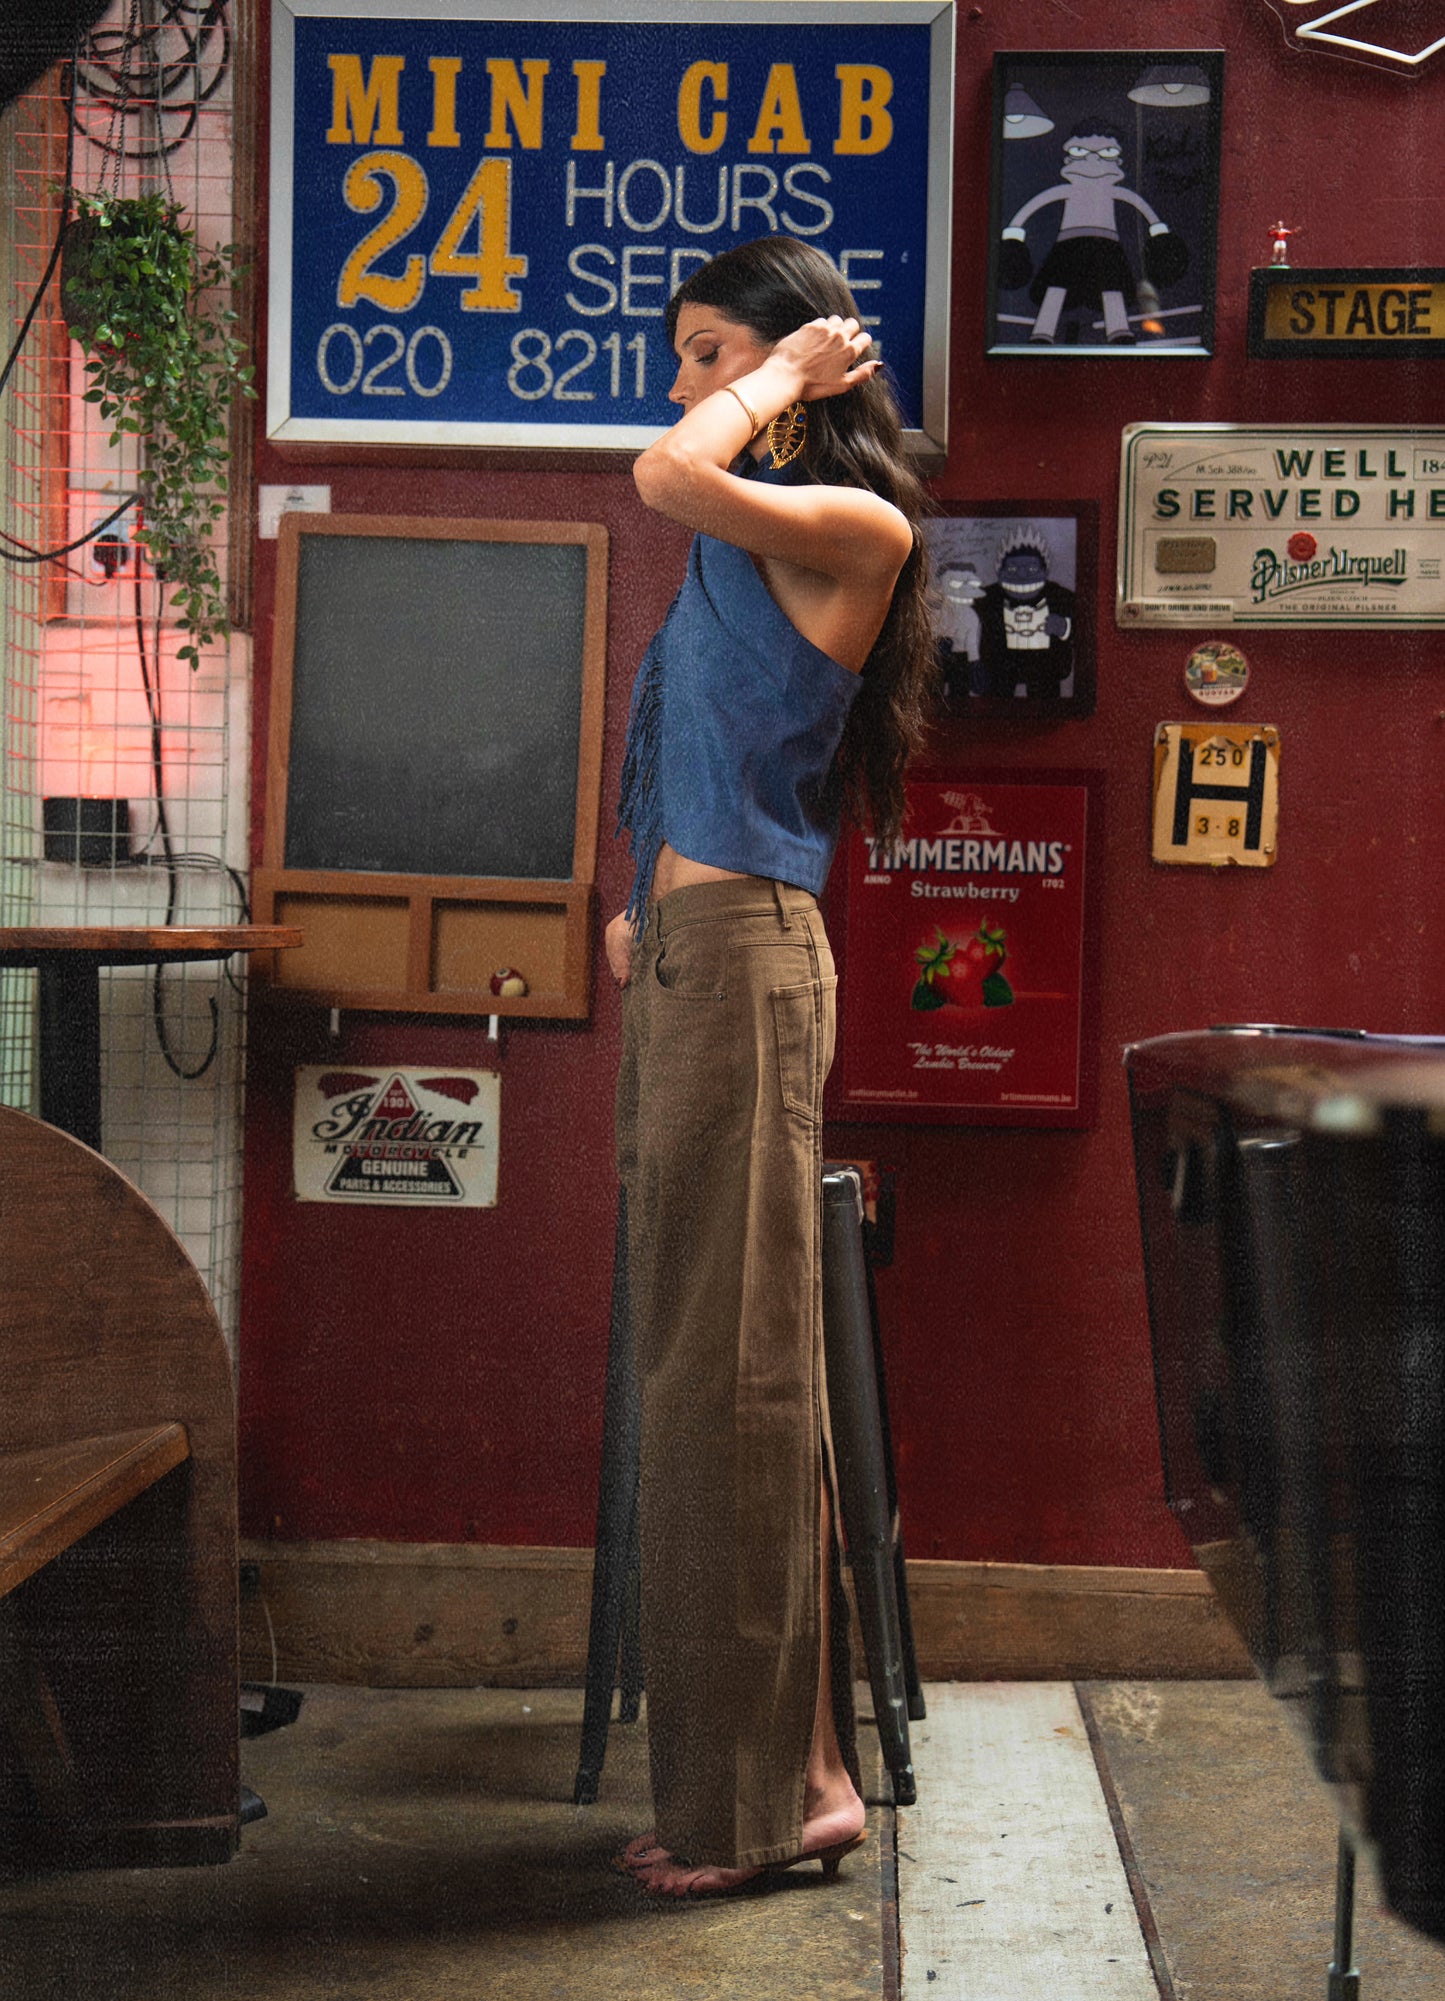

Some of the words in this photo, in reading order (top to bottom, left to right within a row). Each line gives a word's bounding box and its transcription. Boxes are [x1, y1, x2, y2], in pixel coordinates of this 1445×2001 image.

[326, 54, 606, 150] MINI
[677, 60, 893, 155] CAB
[565, 159, 834, 235] HOURS
[337, 151, 527, 313] 24
[1289, 289, 1432, 336] STAGE
[317, 323, 452, 397] 020
[507, 329, 645, 400] 8211
[1274, 449, 1407, 479] WELL
[1153, 488, 1360, 520] SERVED
[1250, 547, 1331, 605] Pilsner
[1329, 546, 1406, 587] Urquell
[1280, 603, 1297, 611] THE
[1302, 603, 1350, 611] ORIGINAL
[1355, 603, 1397, 611] PILSNER
[1200, 748, 1244, 766] 250
[1172, 739, 1267, 850] H
[863, 875, 892, 885] ANNO
[1042, 879, 1066, 889] 1702
[910, 880, 1020, 902] Strawberry
[312, 1093, 484, 1145] Indian
[324, 1144, 469, 1160] MOTORCYCLE
[361, 1160, 429, 1177] GENUINE
[339, 1178, 370, 1191] PARTS
[371, 1180, 380, 1191] &
[382, 1180, 452, 1194] ACCESSORIES
